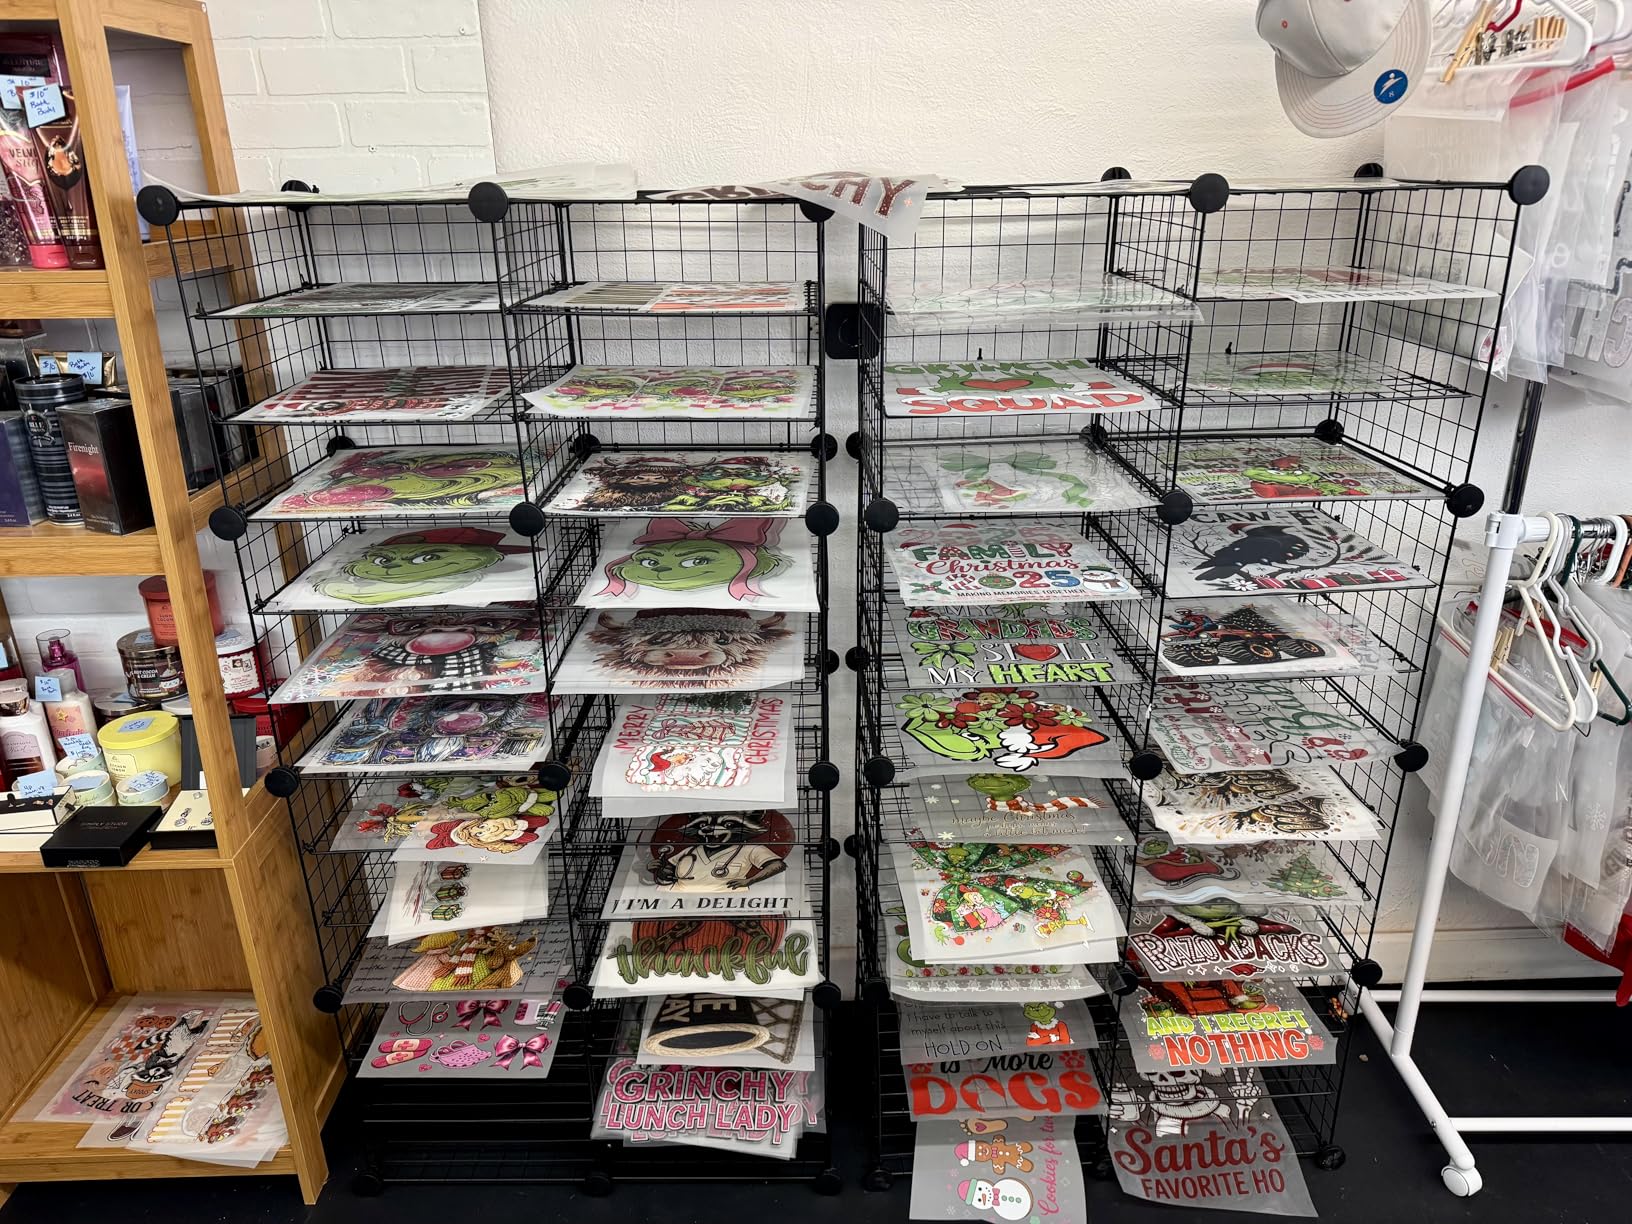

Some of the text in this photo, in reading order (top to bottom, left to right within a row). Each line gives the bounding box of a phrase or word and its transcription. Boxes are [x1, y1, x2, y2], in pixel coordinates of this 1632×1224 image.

[9, 148, 39, 158] VELV
[885, 359, 1090, 375] GRINCH
[901, 391, 1144, 414] SQUAD
[67, 441, 99, 455] Firenight
[911, 541, 1073, 562] FAMILY
[914, 558, 1081, 575] Christmas
[1042, 588, 1087, 596] TOGETHER
[926, 662, 1116, 687] MY HEART
[612, 704, 655, 750] MERRY
[744, 695, 785, 765] CHRISTMAS
[1003, 811, 1076, 822] Christmas
[627, 896, 794, 910] I'M A DELIGHT
[607, 933, 813, 984] thankful
[1130, 932, 1329, 972] RAZORBACKS
[914, 1011, 940, 1021] have
[959, 1008, 978, 1018] talk
[982, 1008, 993, 1017] to
[1146, 1010, 1309, 1036] AND I REGRET
[911, 1023, 946, 1038] myself
[950, 1023, 981, 1032] about
[924, 1034, 1003, 1058] HOLD ON
[1163, 1028, 1310, 1067] NOTHING
[612, 1070, 796, 1102] GRINCHY
[910, 1070, 1102, 1117] DOGS
[72, 1089, 117, 1112] TREAT
[120, 1101, 142, 1114] OR
[605, 1103, 798, 1133] LUNCH LADY
[1114, 1125, 1285, 1176] Santa's
[1038, 1159, 1060, 1216] Cookies
[1140, 1168, 1286, 1200] FAVORITE HO
